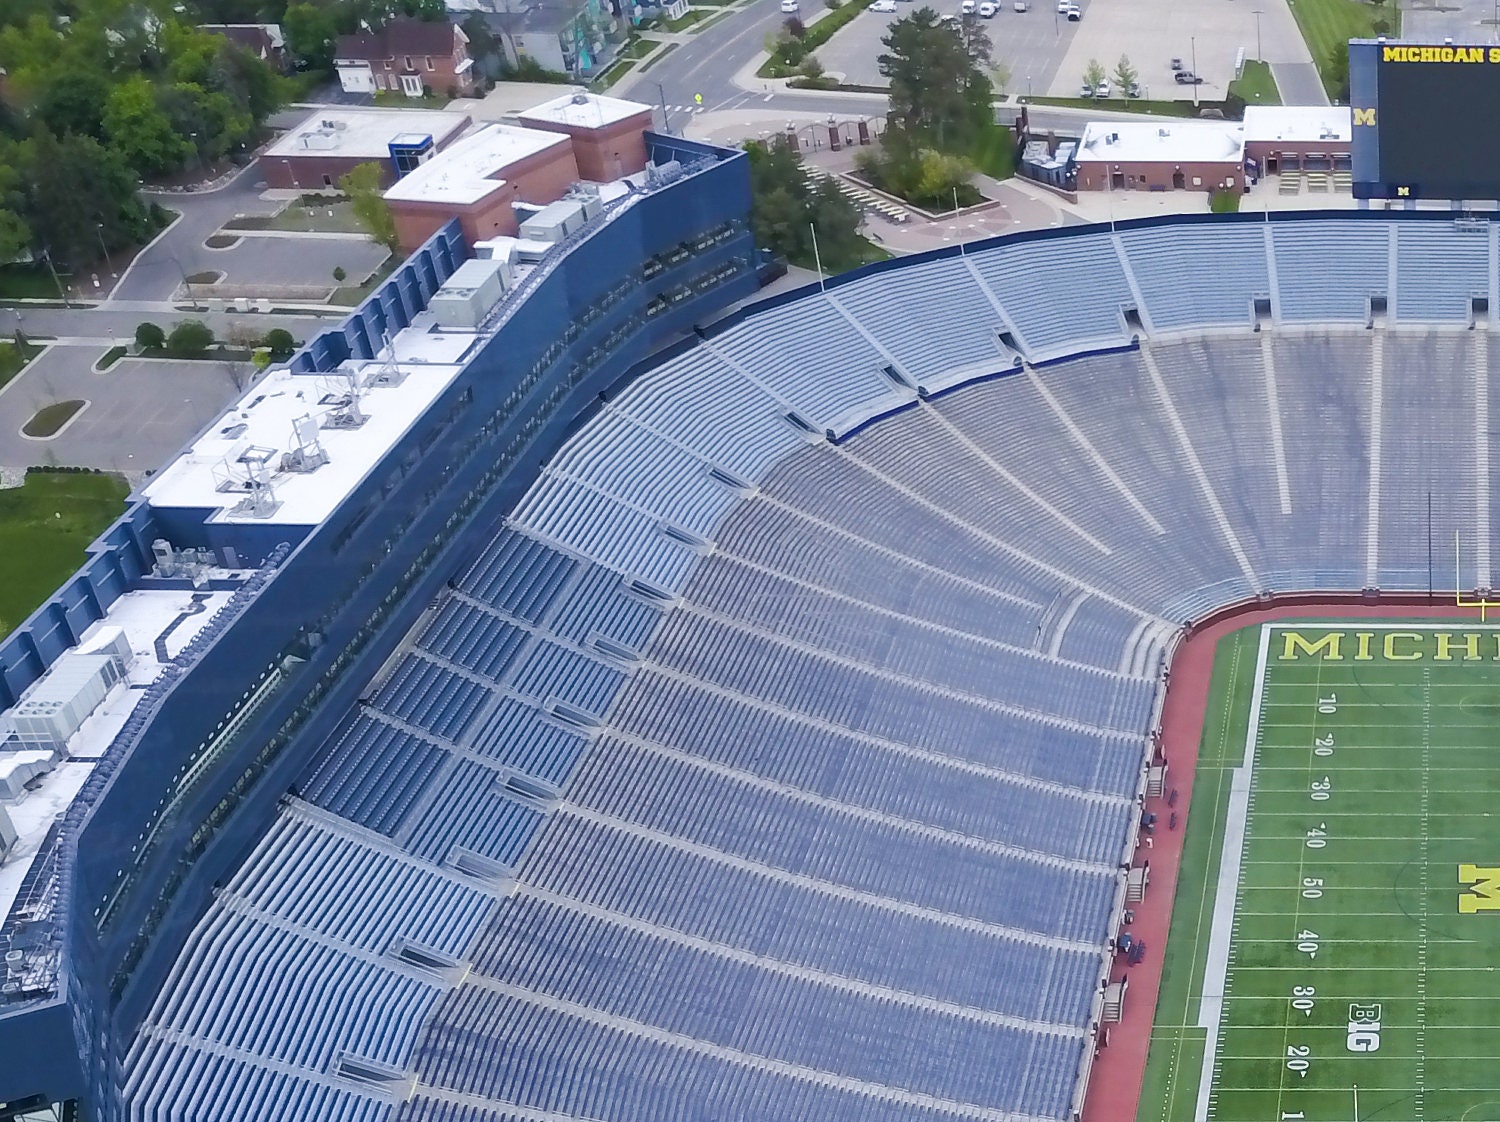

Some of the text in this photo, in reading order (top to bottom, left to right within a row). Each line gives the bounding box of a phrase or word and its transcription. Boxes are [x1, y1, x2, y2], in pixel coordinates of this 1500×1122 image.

[1383, 47, 1484, 63] MICHIGAN
[1353, 108, 1376, 126] M
[1397, 186, 1410, 197] M
[1318, 697, 1337, 714] 10
[1314, 737, 1335, 756] 20
[1310, 781, 1331, 800] 30
[1306, 828, 1328, 848] 40
[1302, 877, 1323, 898] 50
[1297, 929, 1319, 952] 40
[1292, 986, 1315, 1010] 30
[1286, 1045, 1310, 1071] 20
